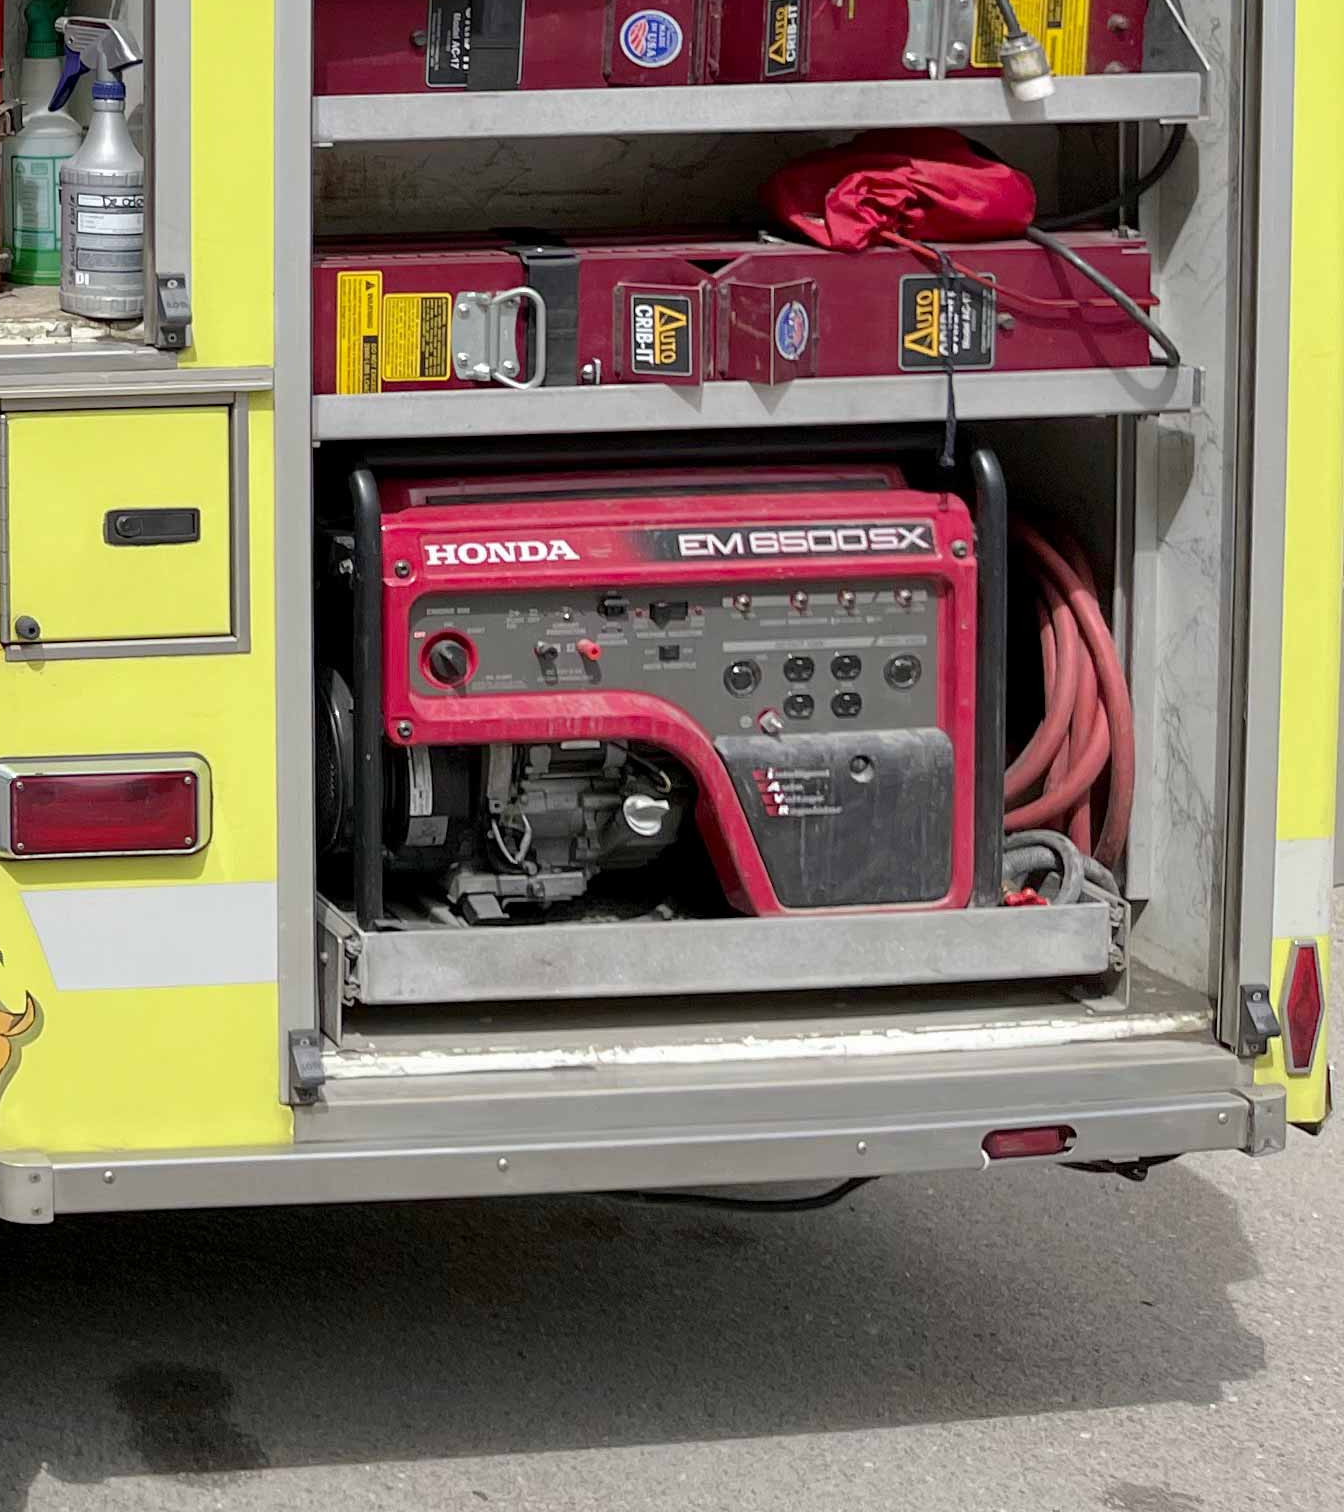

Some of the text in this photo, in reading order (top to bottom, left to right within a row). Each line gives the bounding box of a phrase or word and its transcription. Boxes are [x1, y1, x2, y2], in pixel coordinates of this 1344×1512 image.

[450, 39, 461, 69] AC-17
[647, 33, 657, 57] USA
[769, 6, 788, 64] AUTO
[787, 5, 798, 62] CRIB-IT
[635, 304, 654, 365] CRIB-IT
[654, 305, 687, 365] AUTO
[904, 288, 939, 357] AUTO
[424, 539, 580, 565] HONDA
